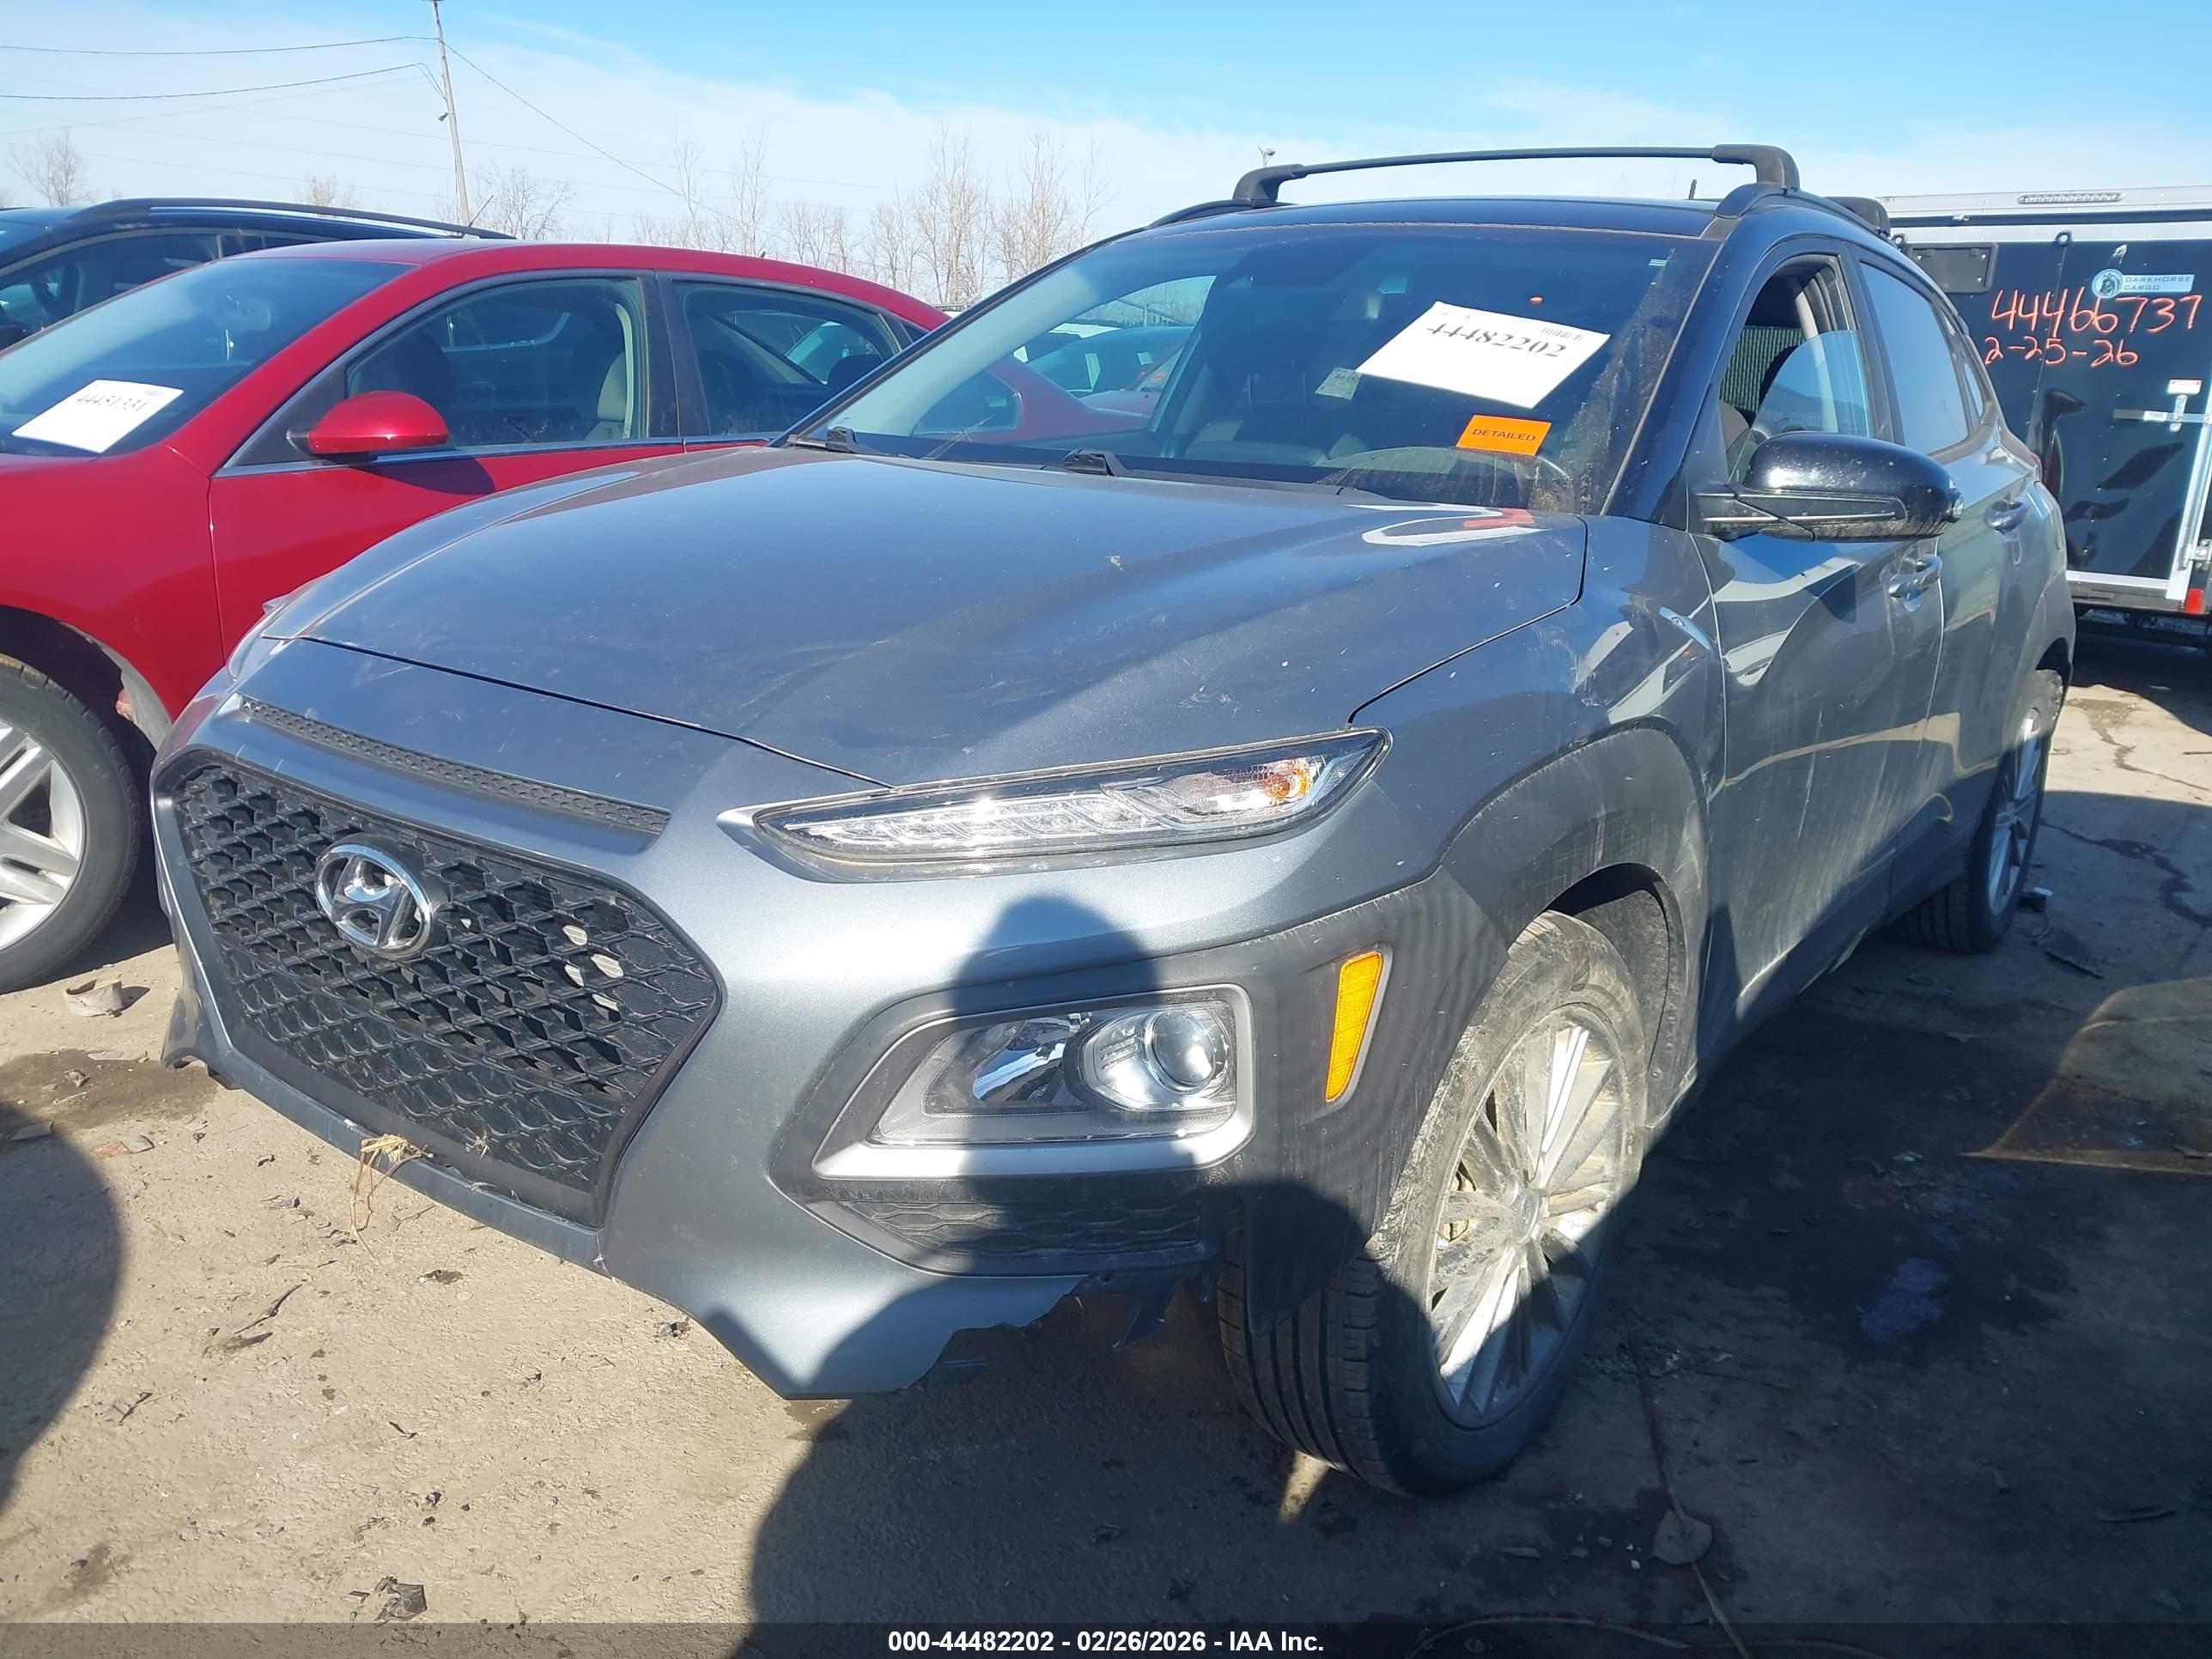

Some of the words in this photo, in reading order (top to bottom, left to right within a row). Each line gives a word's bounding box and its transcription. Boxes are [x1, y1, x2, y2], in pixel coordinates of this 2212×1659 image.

[1991, 287, 2203, 337] 44466737
[1426, 323, 1566, 357] 44482202
[1984, 336, 2138, 368] 2-25-26
[1472, 428, 1536, 442] DETAILED
